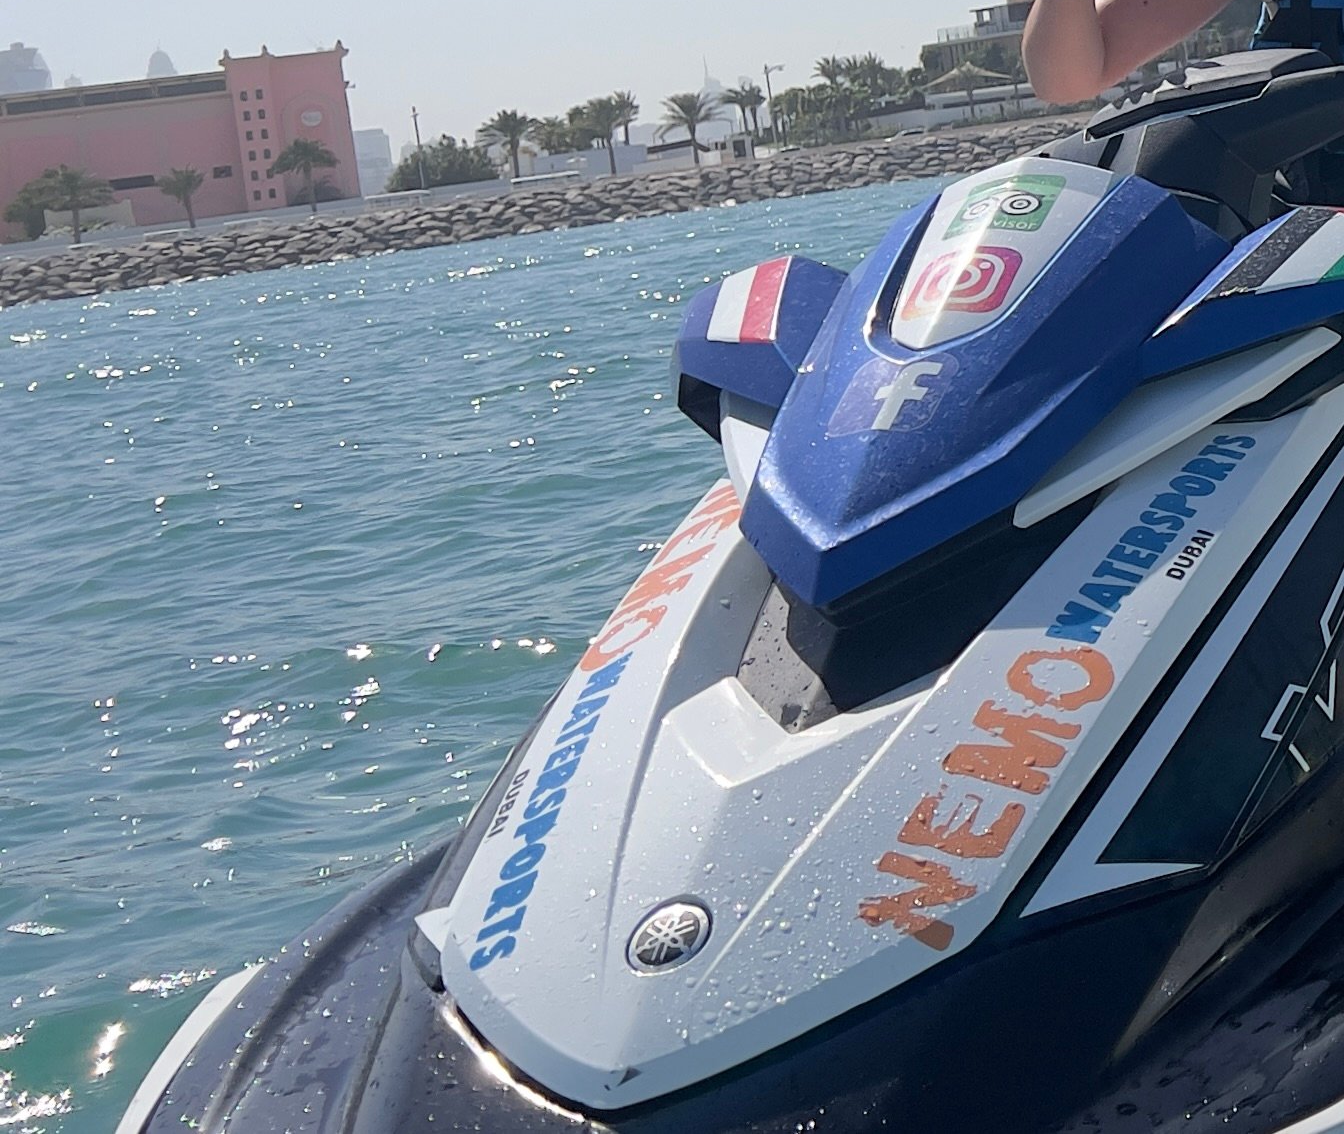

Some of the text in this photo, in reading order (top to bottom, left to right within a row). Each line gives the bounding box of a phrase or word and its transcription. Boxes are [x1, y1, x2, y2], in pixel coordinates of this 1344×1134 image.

[1165, 528, 1216, 581] DUBAI
[856, 434, 1257, 952] NEMO WATERSPORTS
[469, 651, 634, 972] WATERSPORTS
[487, 769, 530, 838] DUBAI
